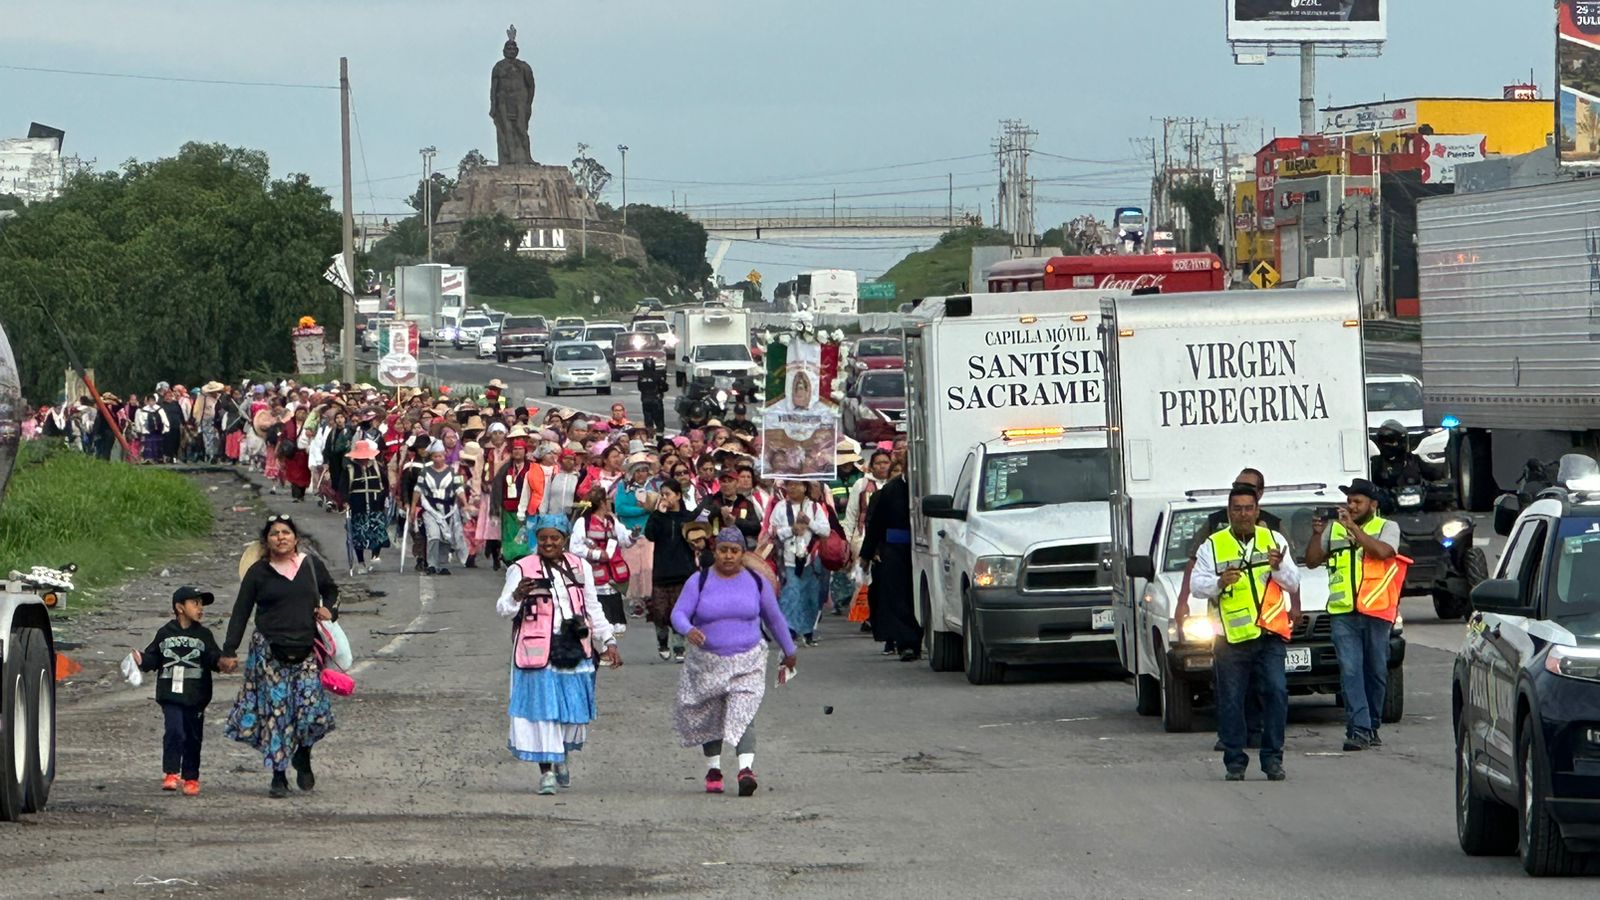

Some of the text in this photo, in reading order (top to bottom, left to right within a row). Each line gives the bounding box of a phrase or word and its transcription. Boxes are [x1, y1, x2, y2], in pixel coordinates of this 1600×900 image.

[985, 329, 1042, 346] CAPILLA
[1046, 324, 1090, 344] MÓVIL
[1185, 340, 1296, 380] VIRGEN
[947, 379, 1107, 410] SACRAME
[1159, 383, 1329, 427] PEREGRINA
